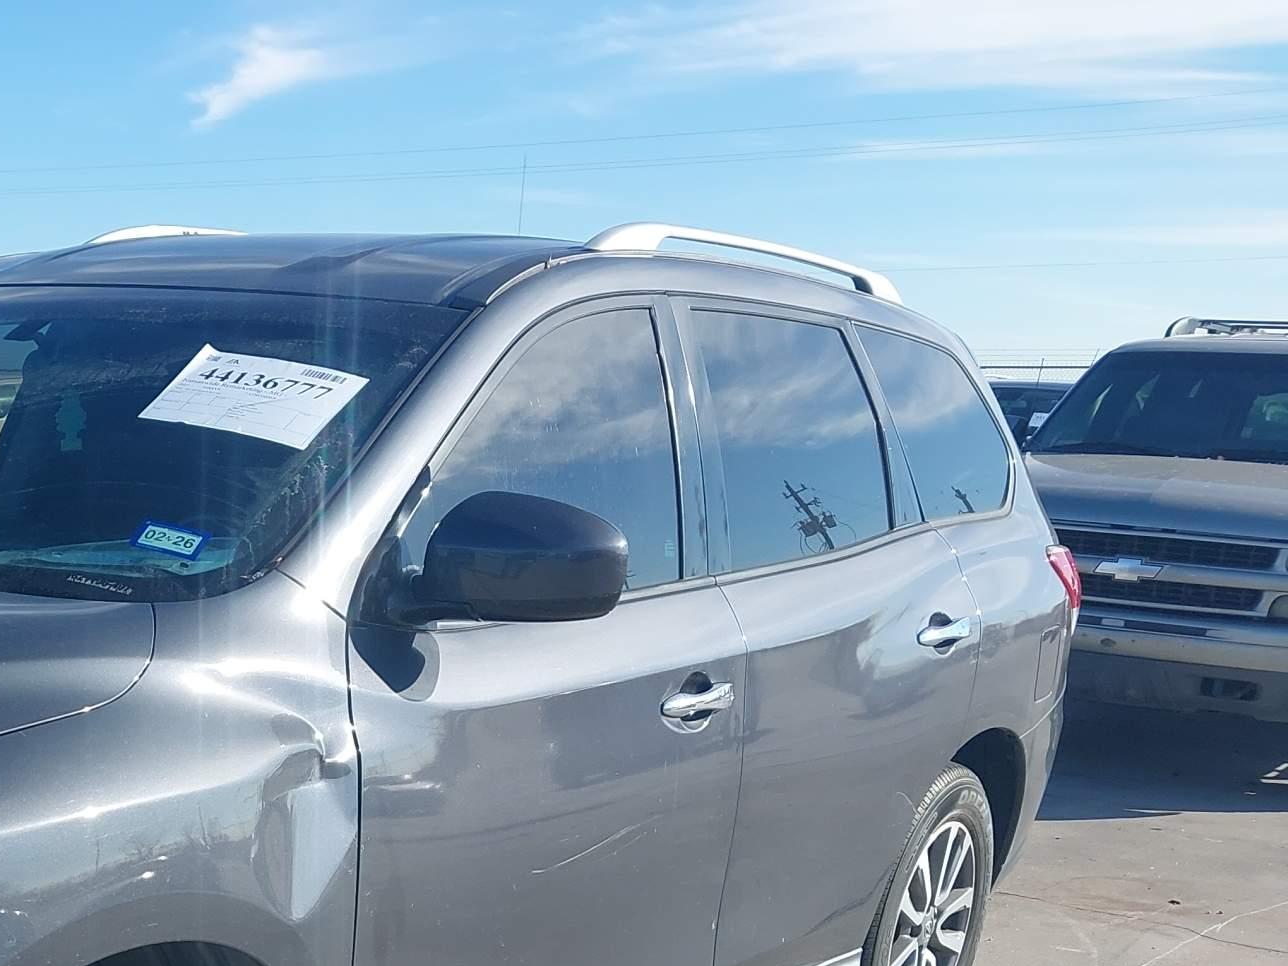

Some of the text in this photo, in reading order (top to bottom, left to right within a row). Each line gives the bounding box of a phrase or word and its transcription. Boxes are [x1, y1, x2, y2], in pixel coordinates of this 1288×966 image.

[198, 366, 334, 399] 44136777
[144, 529, 196, 549] 02 26
